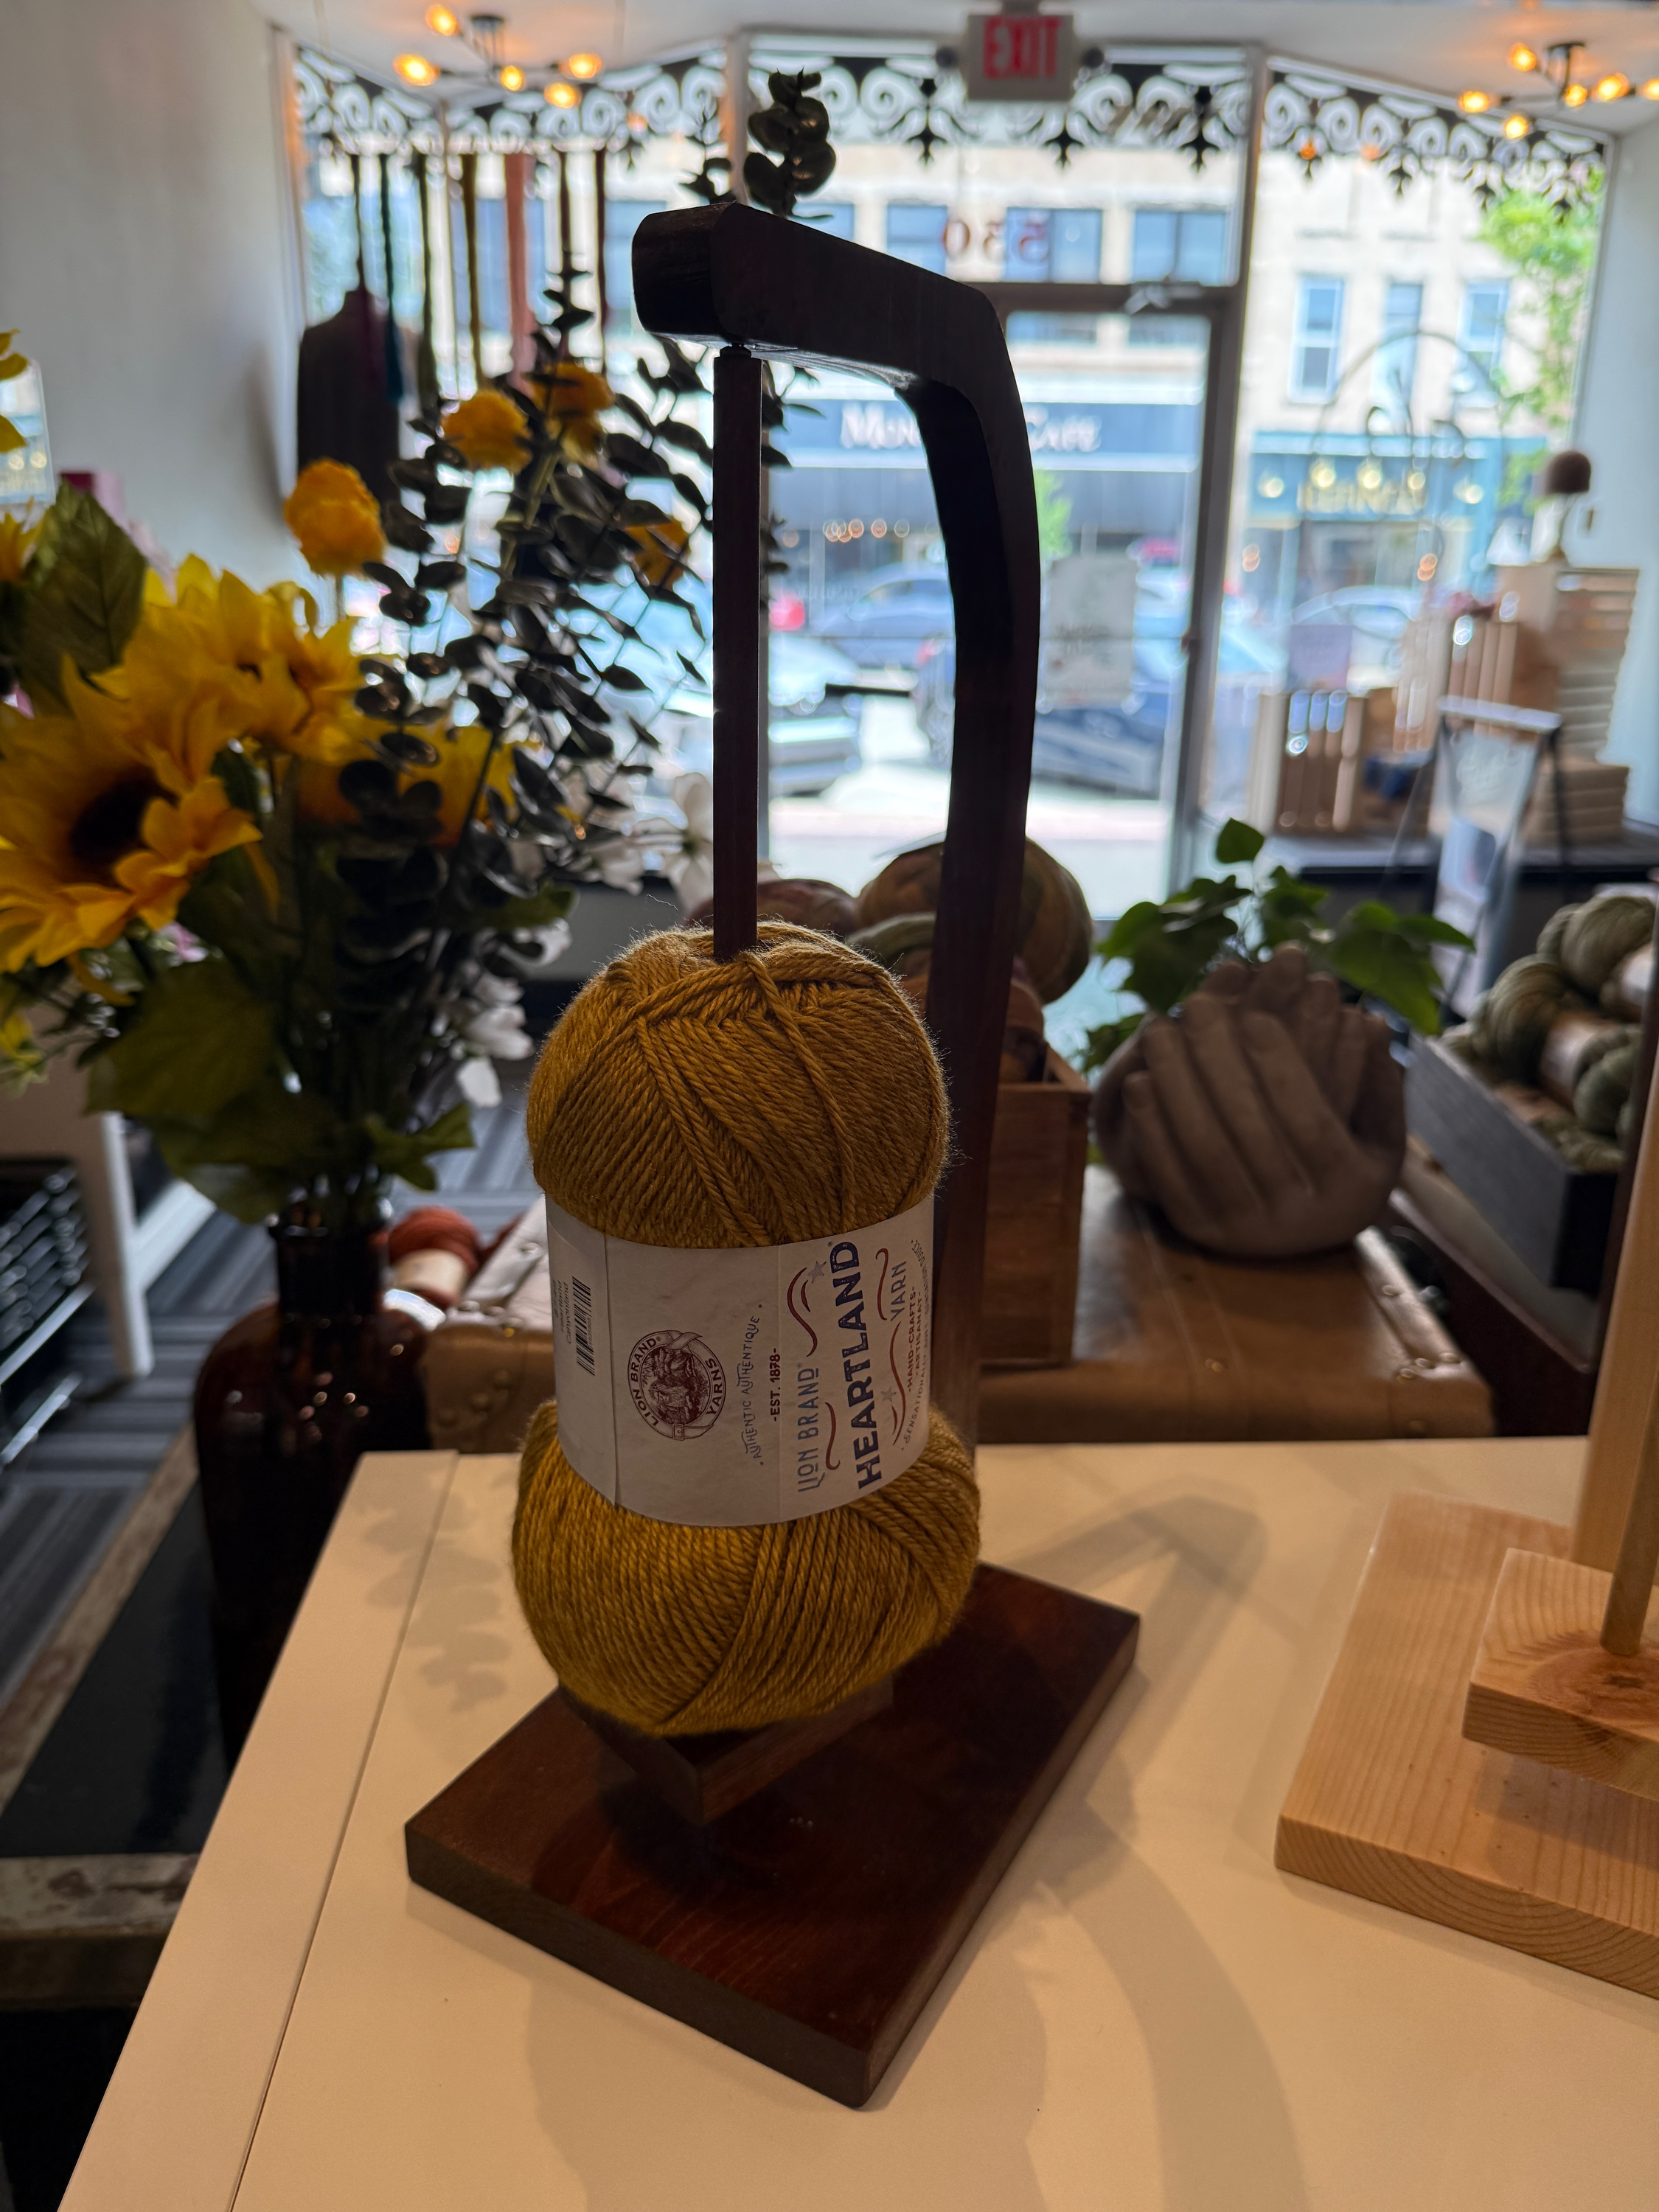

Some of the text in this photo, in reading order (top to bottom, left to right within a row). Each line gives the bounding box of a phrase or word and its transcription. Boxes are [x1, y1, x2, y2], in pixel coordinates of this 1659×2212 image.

[984, 16, 1062, 79] EXIT
[891, 1262, 906, 1321] YARN
[633, 1389, 659, 1426] LION
[705, 1357, 723, 1415] YARNS
[737, 1315, 762, 1458] AUTHENTIC AUTHENTIQUE
[798, 1448, 825, 1492] LION
